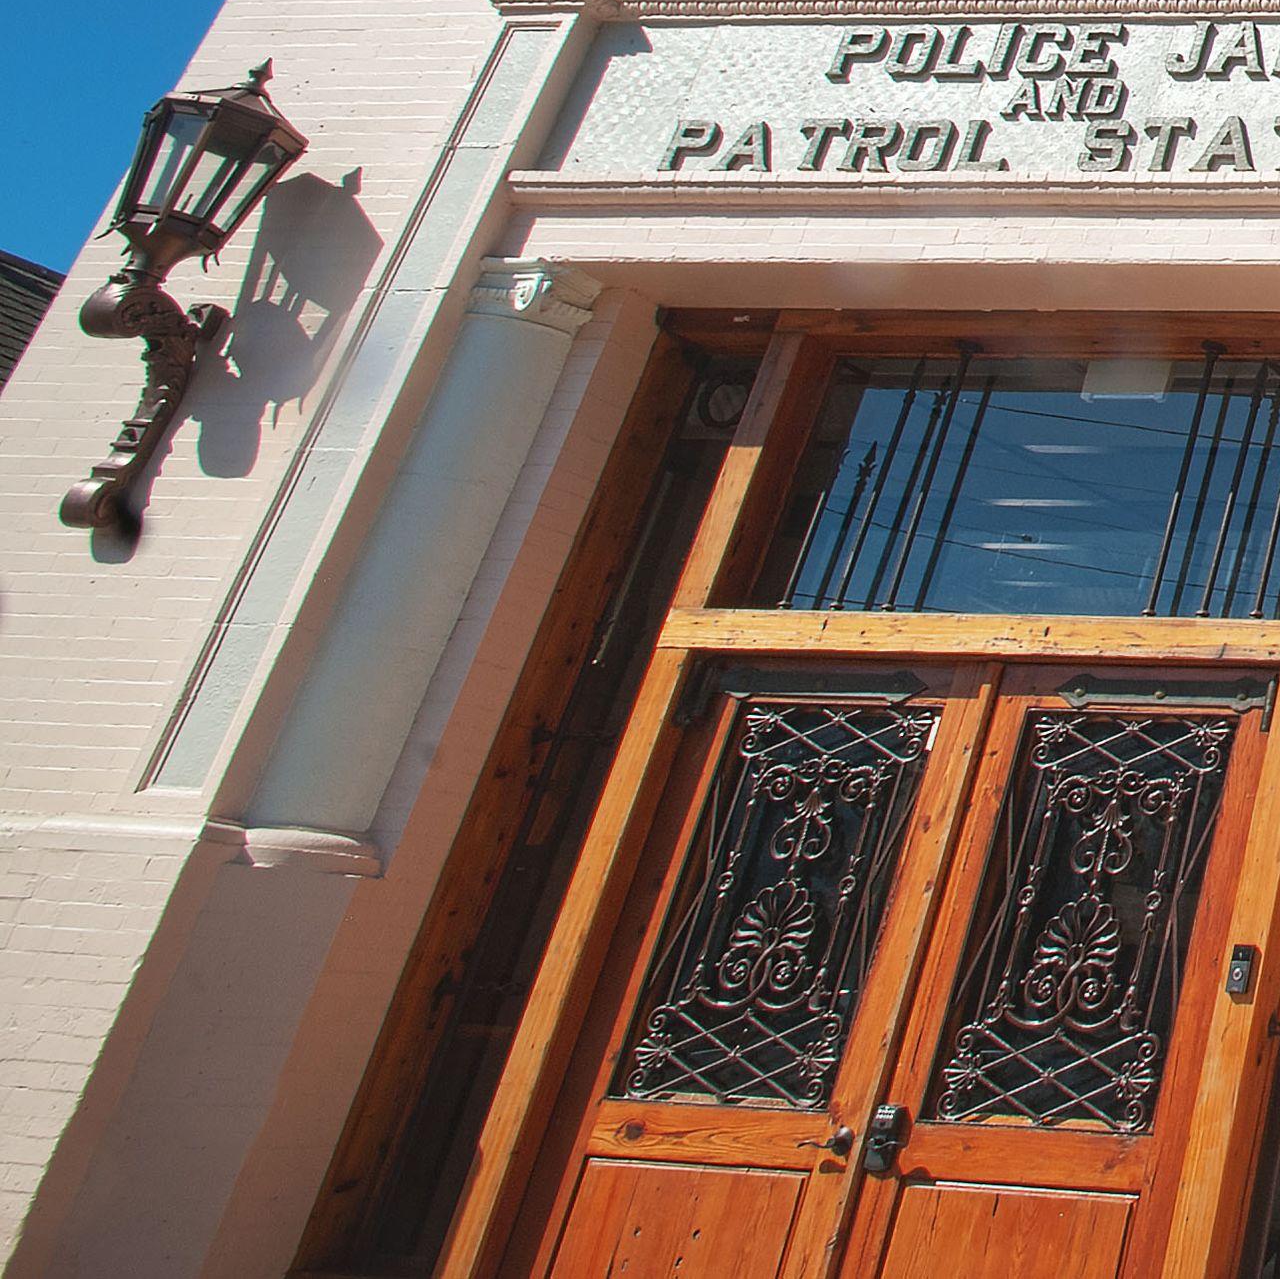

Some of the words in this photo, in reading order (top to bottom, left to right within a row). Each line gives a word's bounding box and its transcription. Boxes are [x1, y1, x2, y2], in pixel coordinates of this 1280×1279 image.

[825, 21, 1129, 83] POLICE
[1001, 77, 1129, 121] AND
[658, 118, 1009, 173] PATROL
